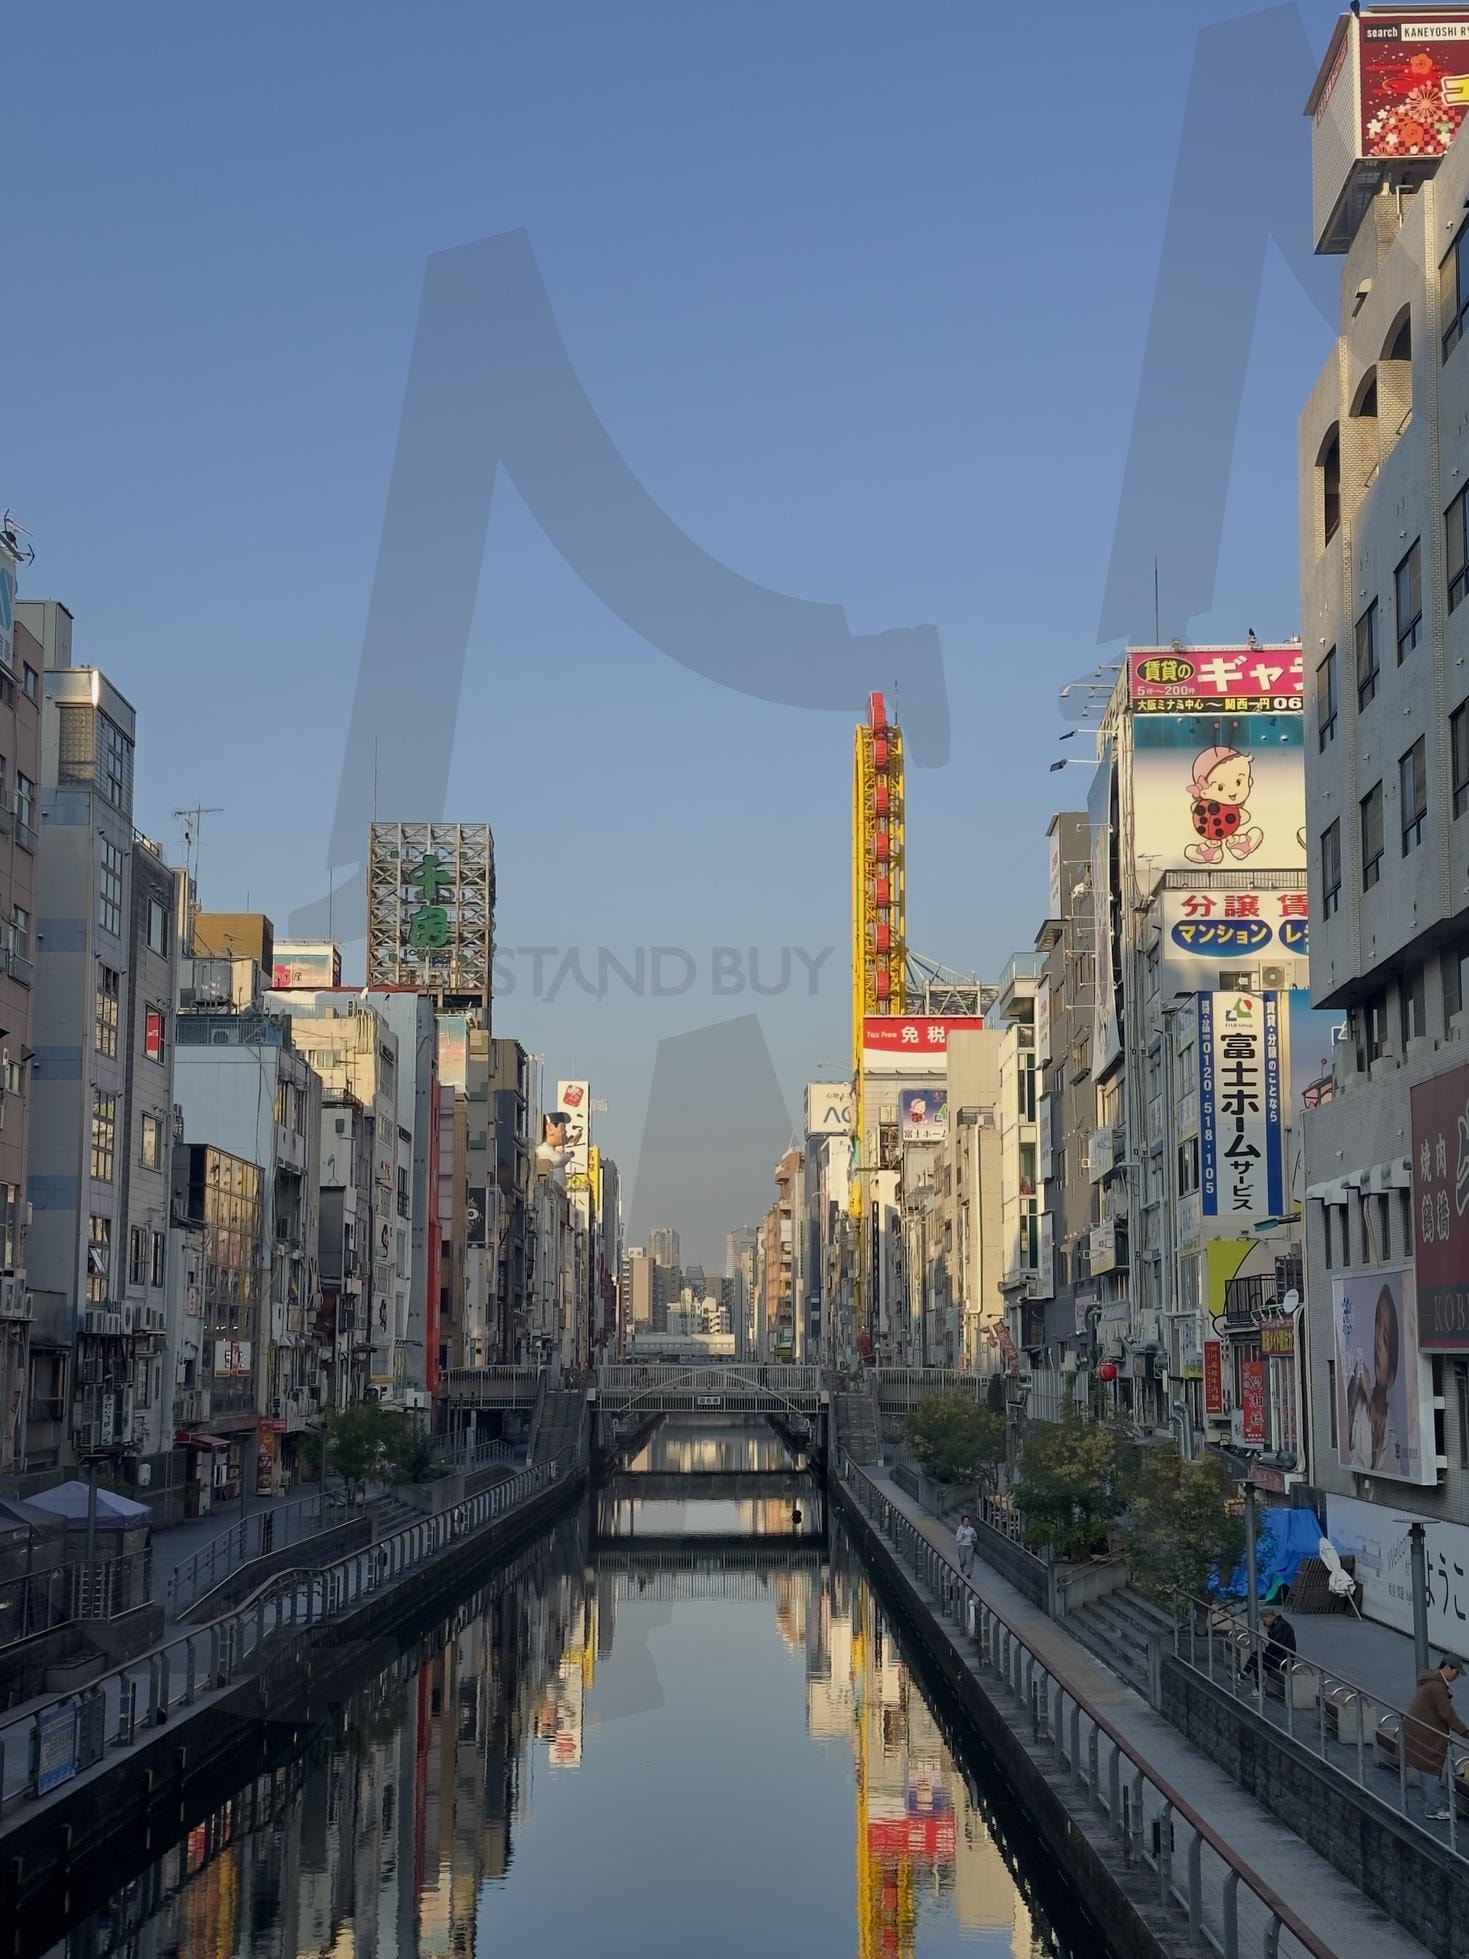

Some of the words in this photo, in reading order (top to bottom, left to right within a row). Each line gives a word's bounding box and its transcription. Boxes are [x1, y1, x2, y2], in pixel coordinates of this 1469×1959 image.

[1366, 26, 1398, 38] search
[1404, 26, 1457, 38] KANEYOSHI
[1144, 660, 1191, 682] 賃貸の
[1178, 924, 1267, 945] マンション
[901, 1026, 945, 1044] 免税
[1220, 1032, 1261, 1211] 富士ホームサービス
